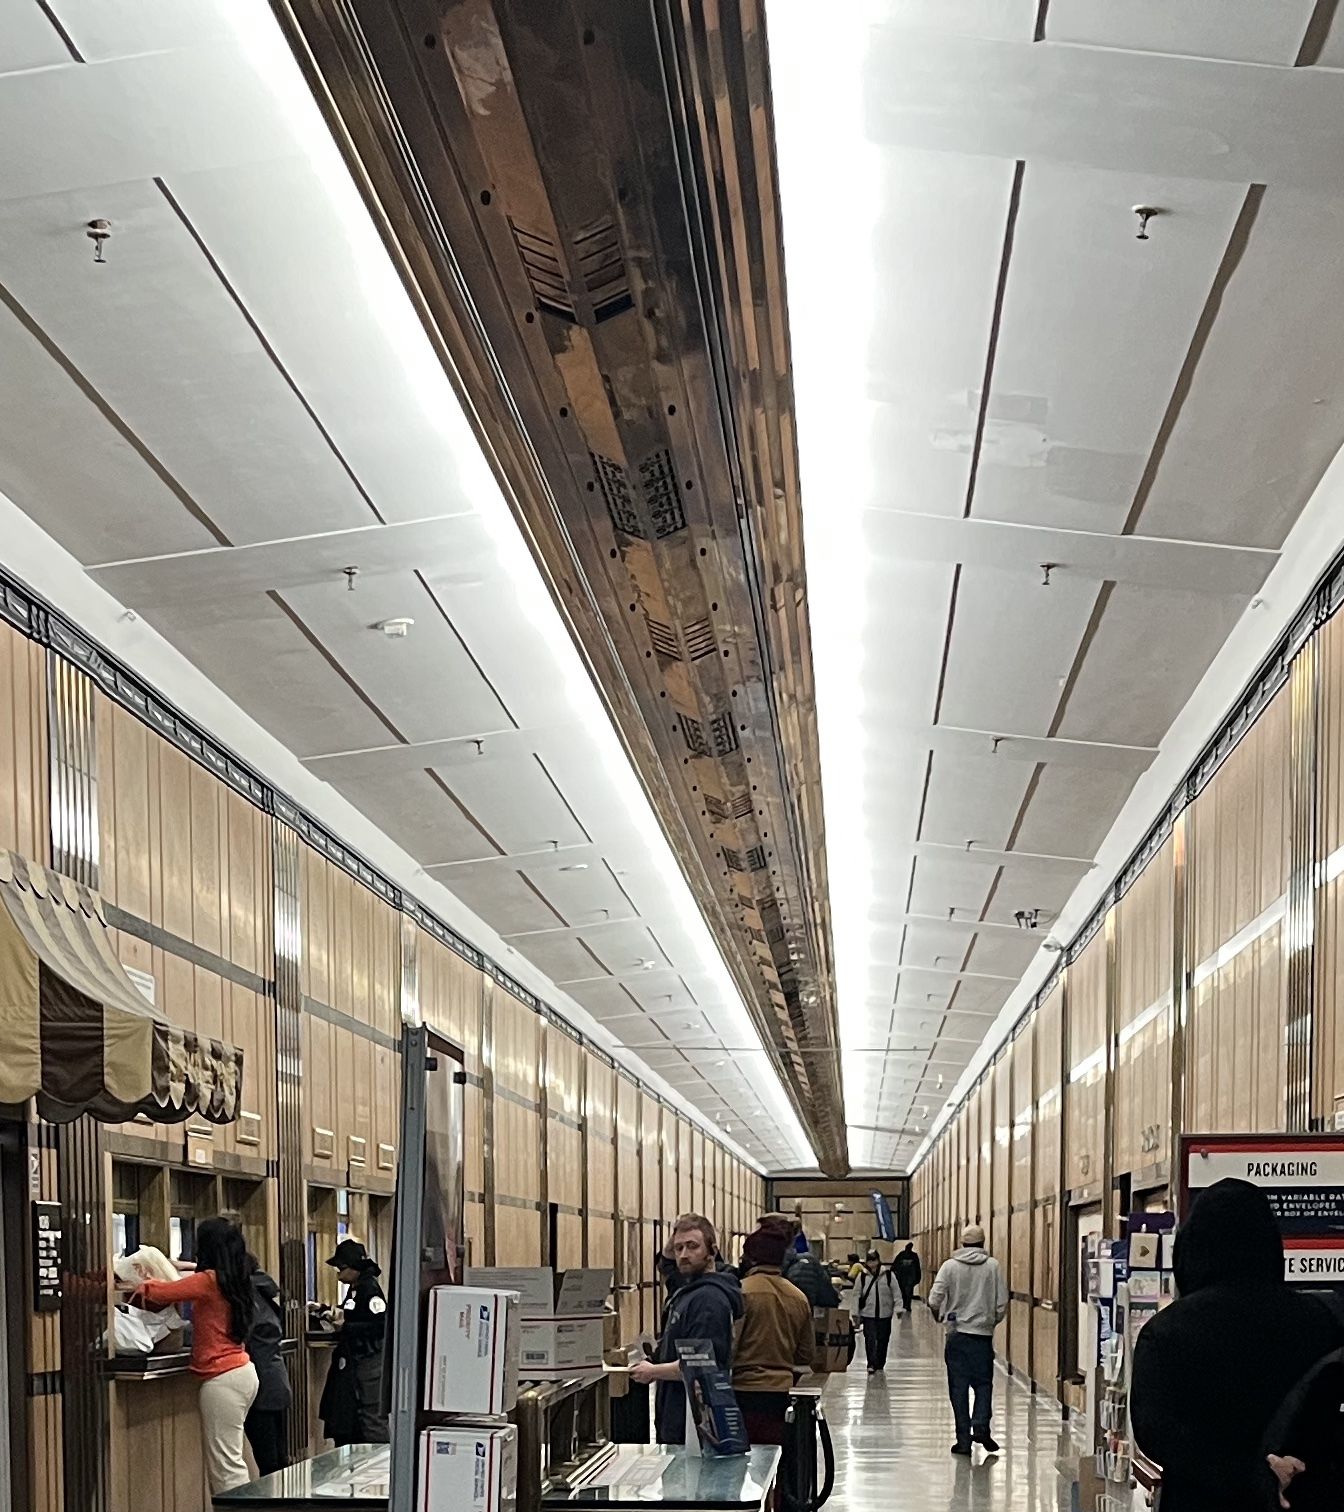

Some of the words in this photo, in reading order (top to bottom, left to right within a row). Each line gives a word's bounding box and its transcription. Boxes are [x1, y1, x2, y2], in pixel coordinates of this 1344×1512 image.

[1246, 1161, 1318, 1177] PACKAGING
[1281, 1193, 1325, 1201] VARIABLE
[1285, 1257, 1295, 1273] E
